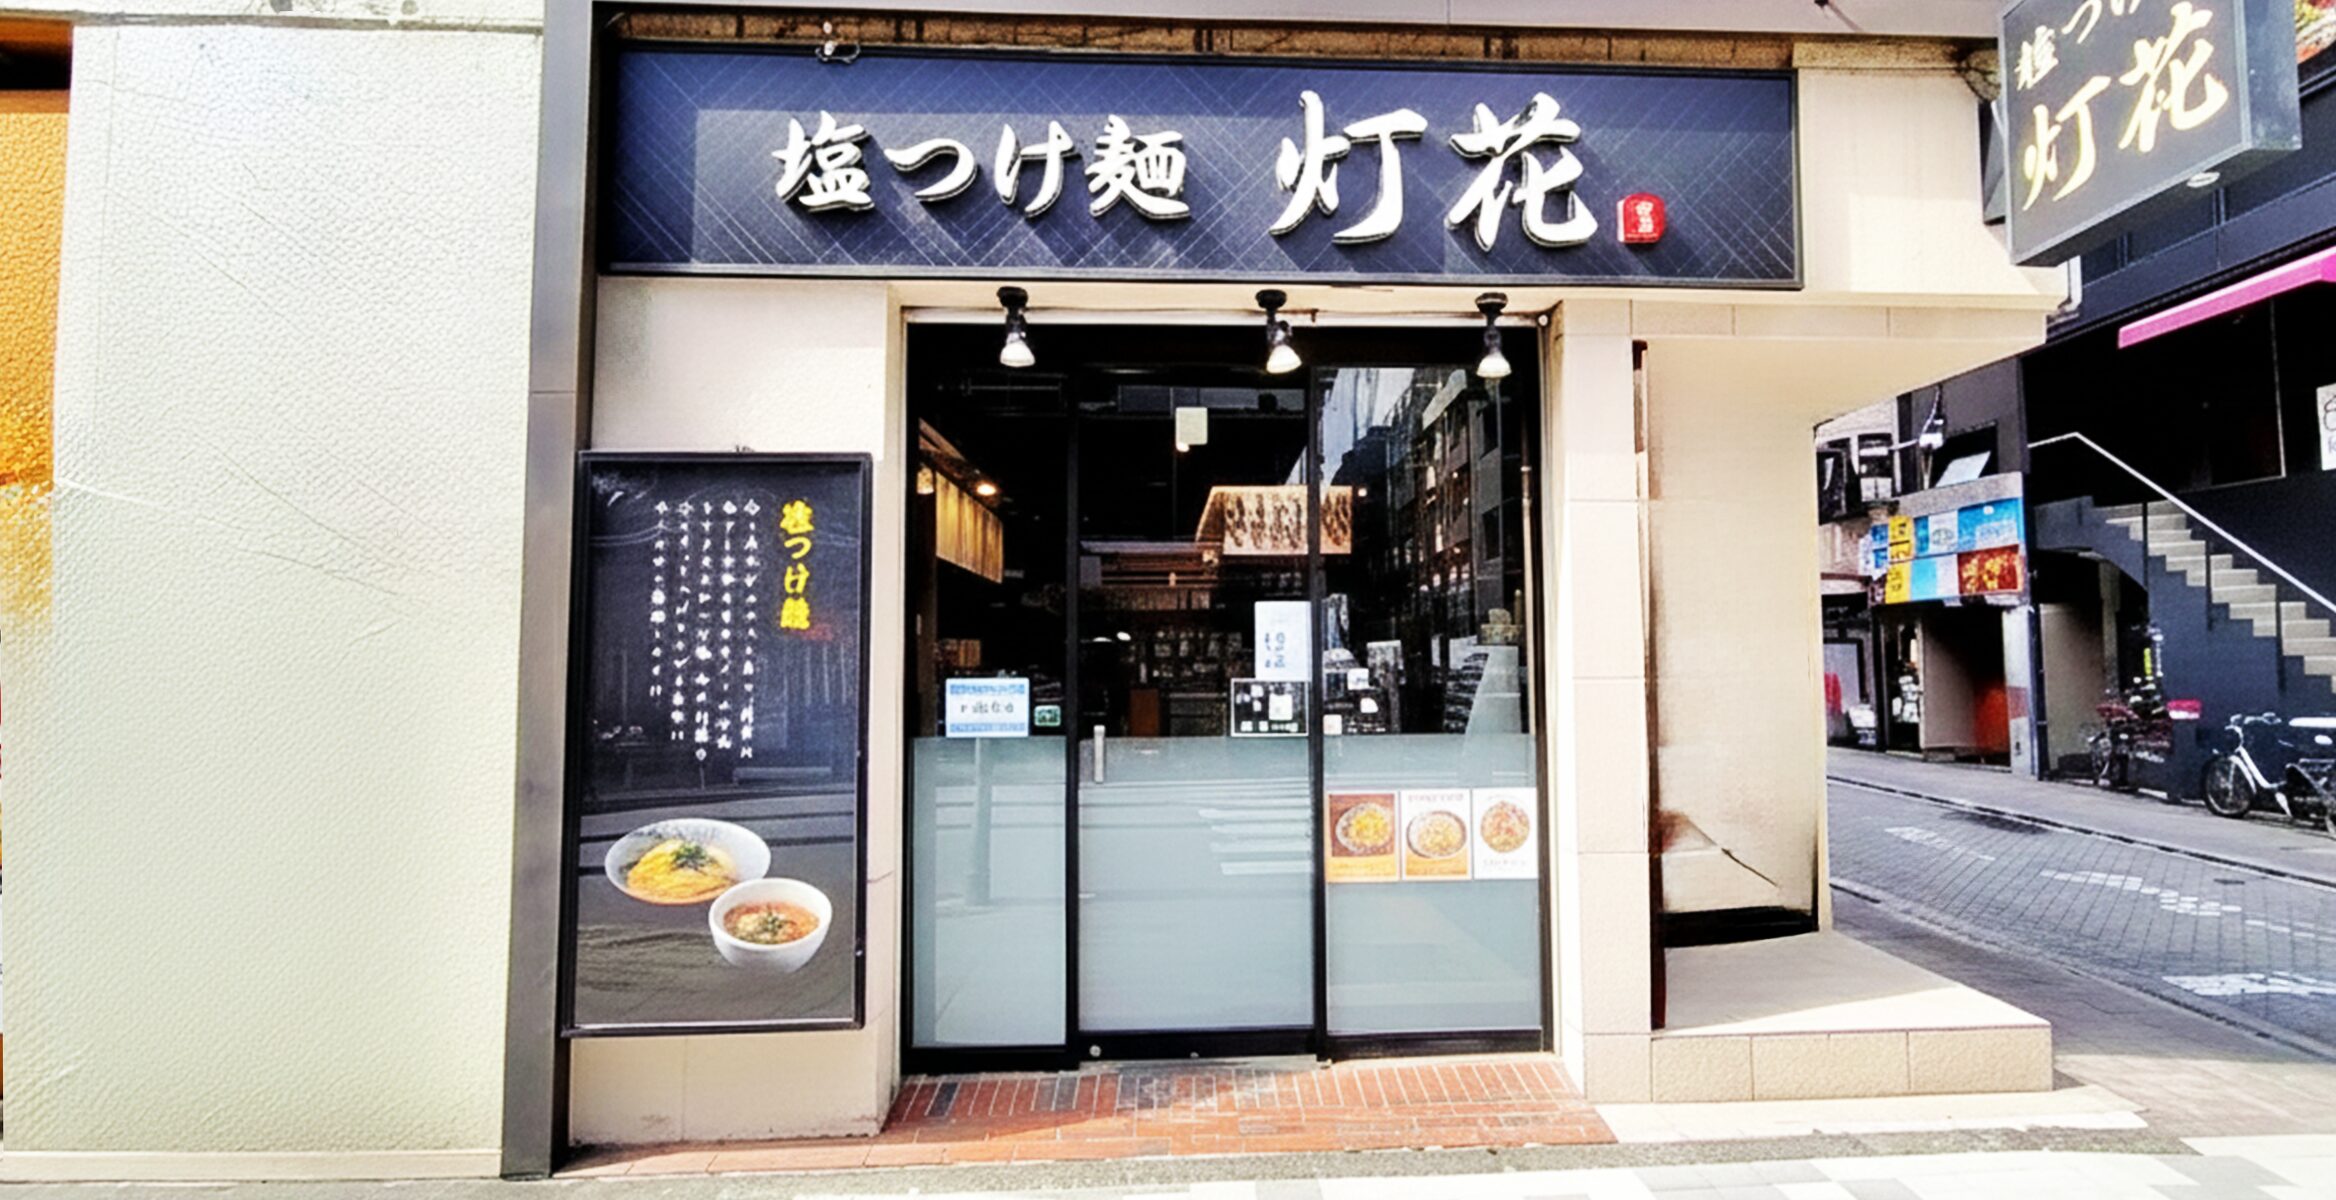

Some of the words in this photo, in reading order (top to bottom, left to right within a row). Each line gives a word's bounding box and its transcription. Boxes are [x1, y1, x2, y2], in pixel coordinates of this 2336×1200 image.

[770, 110, 1191, 220] 塩つけ麺
[1269, 90, 1599, 251] 灯花
[2022, 1, 2230, 212] 灯花
